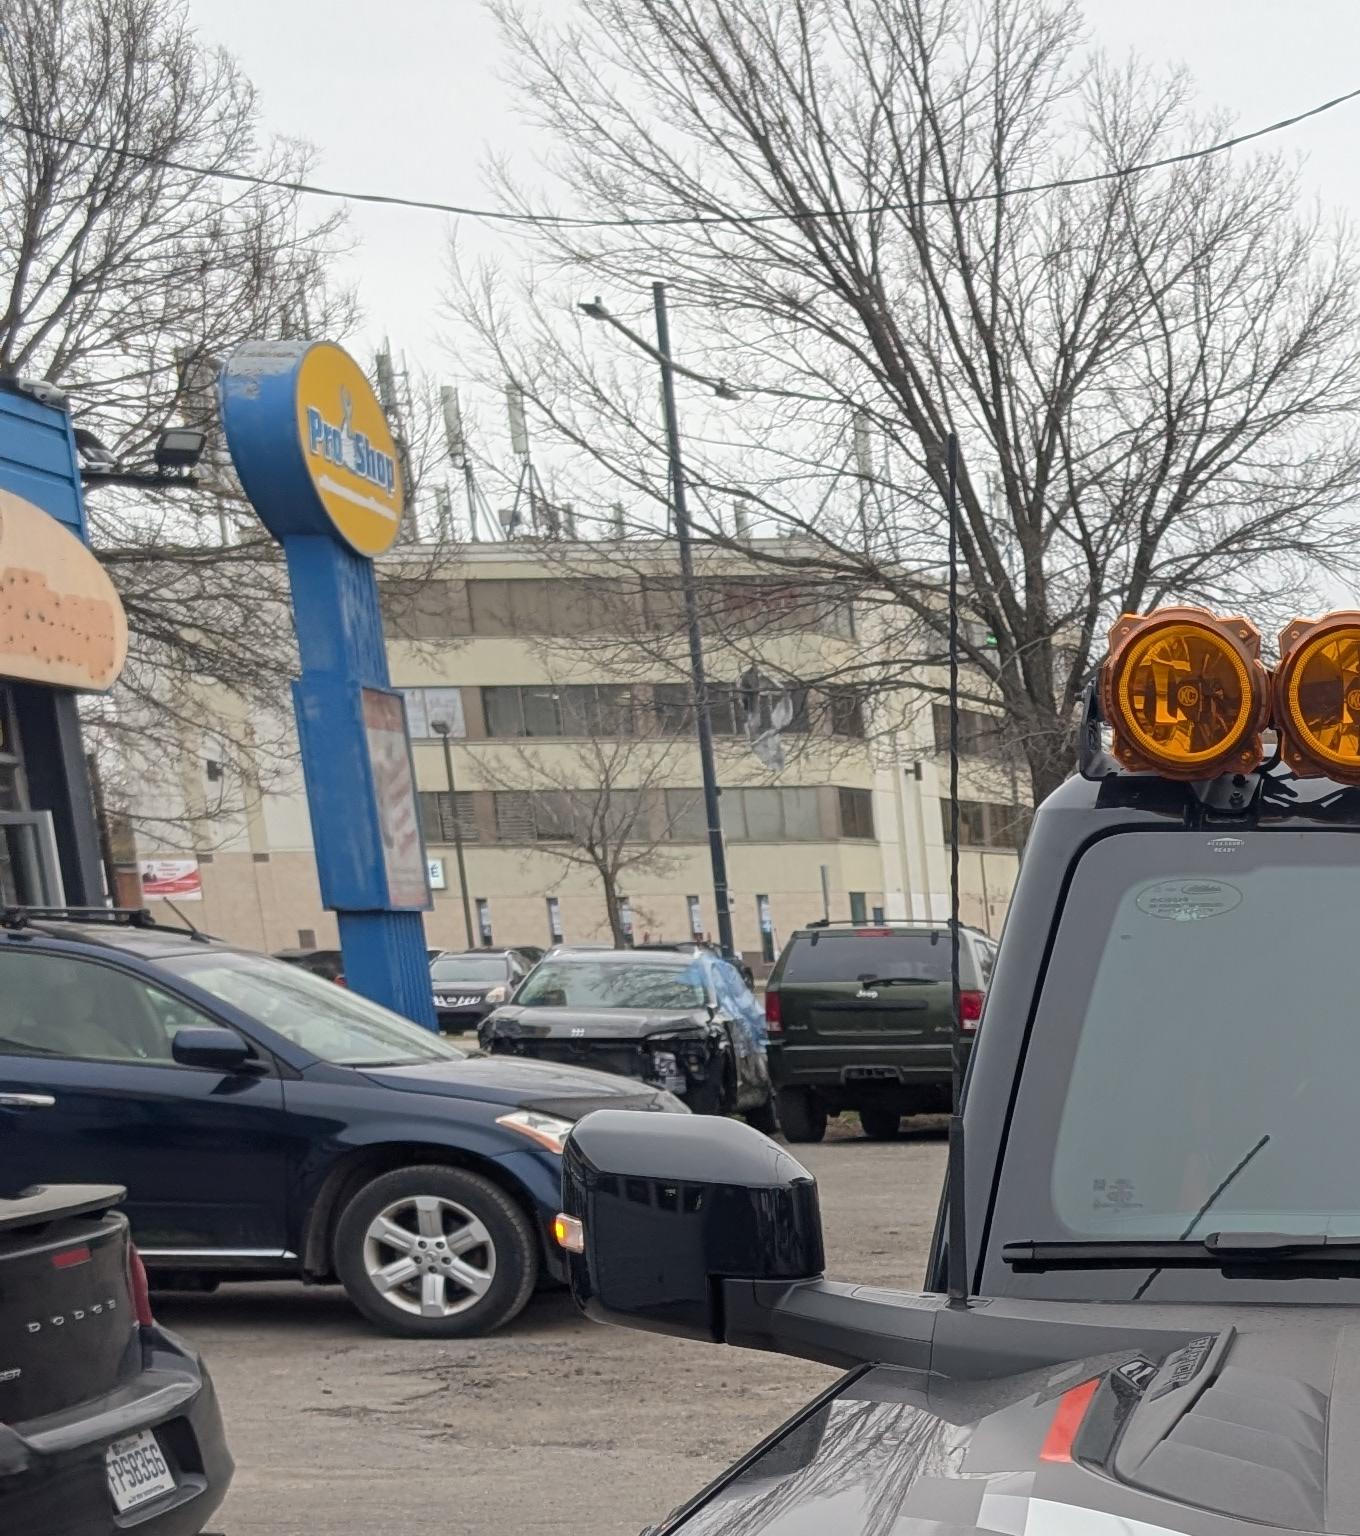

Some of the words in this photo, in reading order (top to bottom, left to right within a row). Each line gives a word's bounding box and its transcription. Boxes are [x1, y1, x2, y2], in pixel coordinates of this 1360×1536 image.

[307, 406, 344, 466] Pro
[352, 431, 395, 498] Shop
[856, 990, 878, 998] Jeep
[27, 1299, 116, 1333] DODGE
